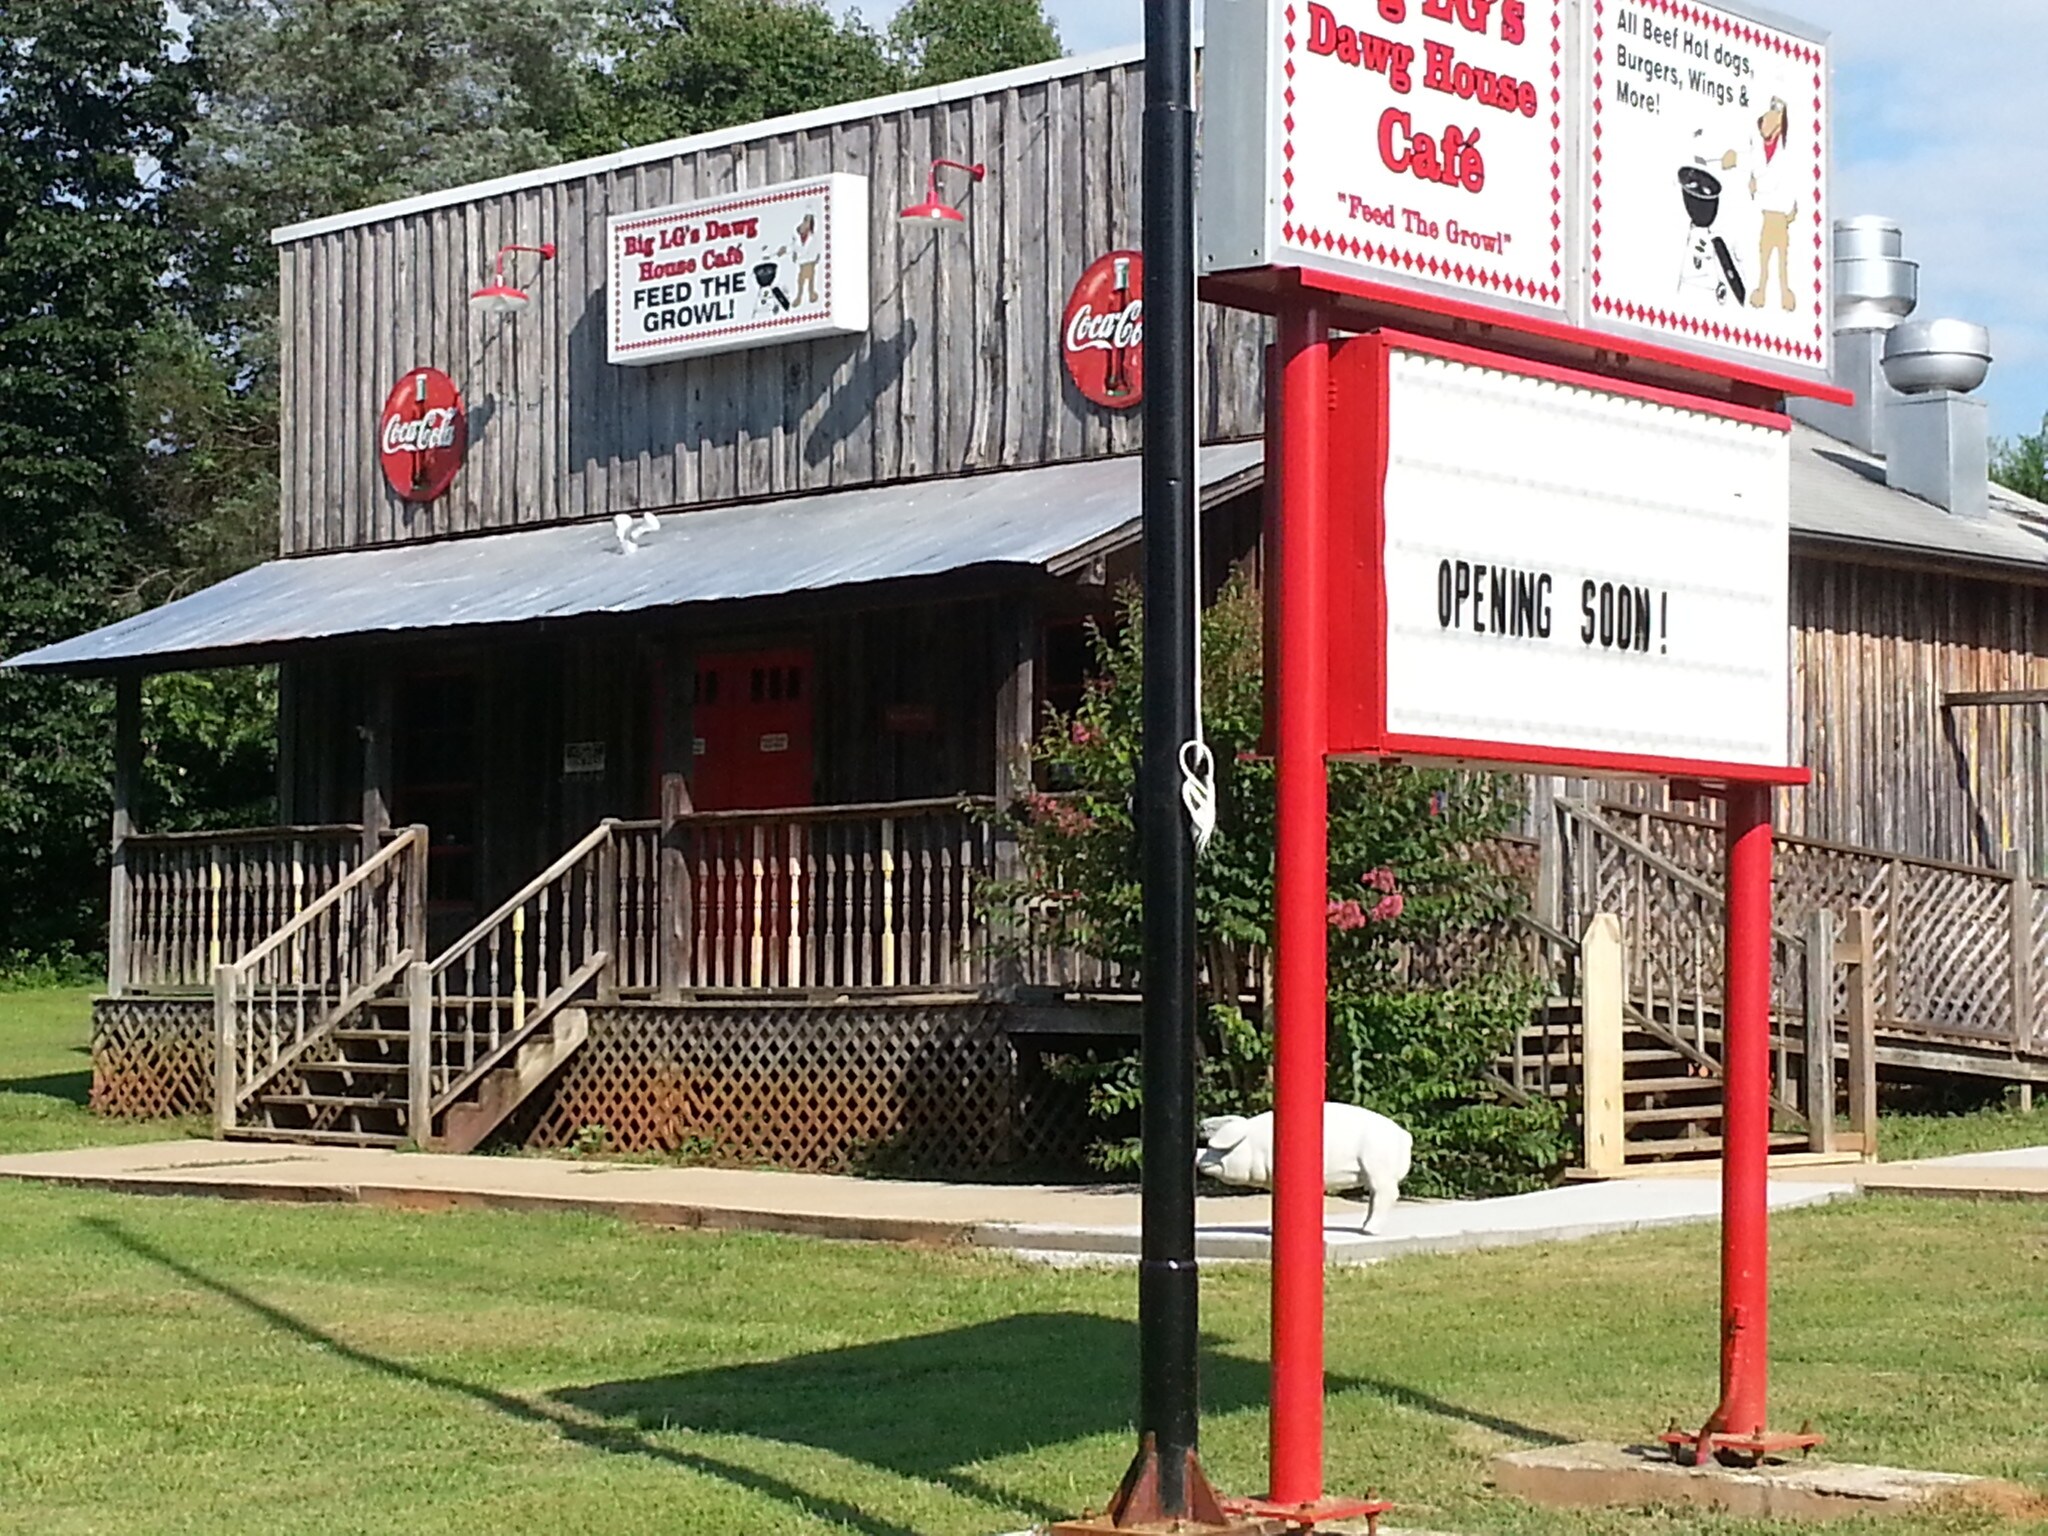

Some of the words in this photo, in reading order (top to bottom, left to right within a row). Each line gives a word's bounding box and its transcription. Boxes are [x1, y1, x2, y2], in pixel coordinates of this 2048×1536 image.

[1422, 0, 1525, 45] Gs
[1617, 8, 1637, 35] All
[1643, 17, 1678, 50] Beef
[1683, 30, 1709, 60] Hot
[1714, 43, 1754, 79] dogs,
[1307, 1, 1414, 94] Dawg
[1423, 38, 1537, 118] House
[1617, 43, 1683, 91] Burgers,
[1688, 68, 1734, 106] Wings
[1739, 84, 1749, 108] &
[1616, 79, 1660, 115] More!
[1377, 107, 1484, 194] Café
[624, 234, 655, 258] Big
[659, 224, 700, 250] LG's
[705, 217, 758, 242] Dawg
[1338, 191, 1395, 229] "Feed
[1402, 208, 1439, 240] The
[1446, 218, 1512, 256] Growl"
[638, 258, 696, 282] House
[701, 243, 743, 271] Café
[633, 281, 691, 310] FEED
[700, 271, 747, 298] THE
[643, 299, 735, 333] GROWL!
[1067, 299, 1142, 351] Coca-Co
[382, 407, 457, 454] Coca-Cola
[1437, 558, 1552, 638] OPENING
[1580, 578, 1668, 655] SOON!
